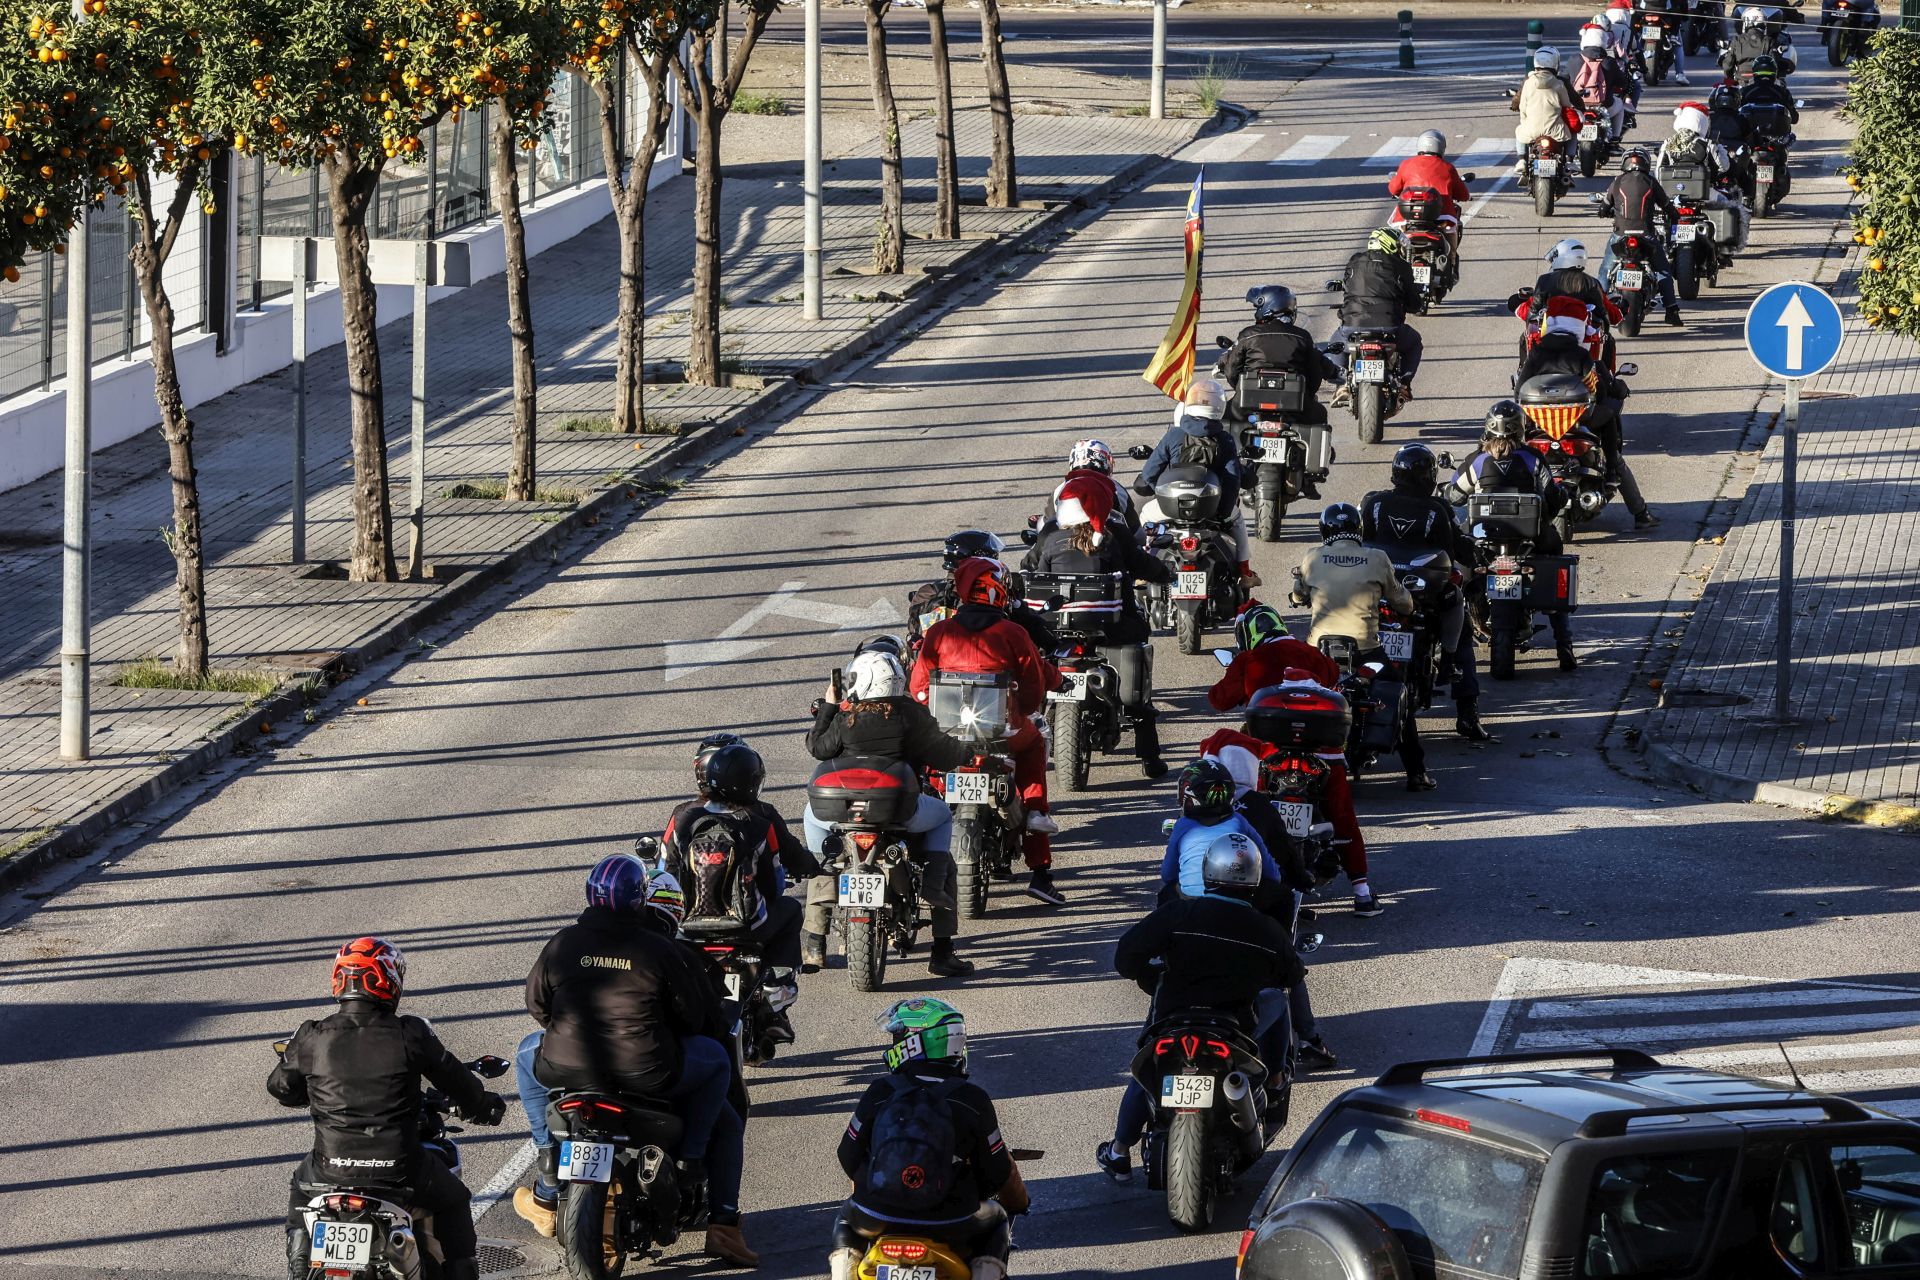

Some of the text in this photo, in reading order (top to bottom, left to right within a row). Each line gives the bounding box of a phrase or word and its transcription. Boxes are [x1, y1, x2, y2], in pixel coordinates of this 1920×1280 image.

[1622, 273, 1641, 281] 3289
[1622, 280, 1636, 288] MNW
[1362, 361, 1383, 370] 1259
[1362, 369, 1377, 378] FYF
[1262, 439, 1283, 449] 0381
[1265, 449, 1277, 458] TK
[1322, 554, 1368, 566] TRIUMPH
[1181, 573, 1205, 584] 1025
[1494, 576, 1520, 587] 6354
[1179, 584, 1198, 594] LNZ
[1498, 587, 1518, 598] FMC
[1384, 633, 1411, 645] 2051
[956, 776, 986, 788] 3413
[960, 788, 982, 801] KZR
[1279, 804, 1310, 818] 5371
[1286, 817, 1301, 830] NC
[850, 877, 882, 891] 3557
[849, 892, 873, 904] LWG
[592, 956, 632, 971] YAMAHA
[1176, 1078, 1212, 1091] 5429
[1174, 1092, 1201, 1105] JJP
[573, 1145, 608, 1162] 8831
[329, 1157, 396, 1168] alpinestars
[570, 1162, 598, 1178] LTZ
[326, 1226, 368, 1244] 3530
[324, 1244, 356, 1261] MLB
